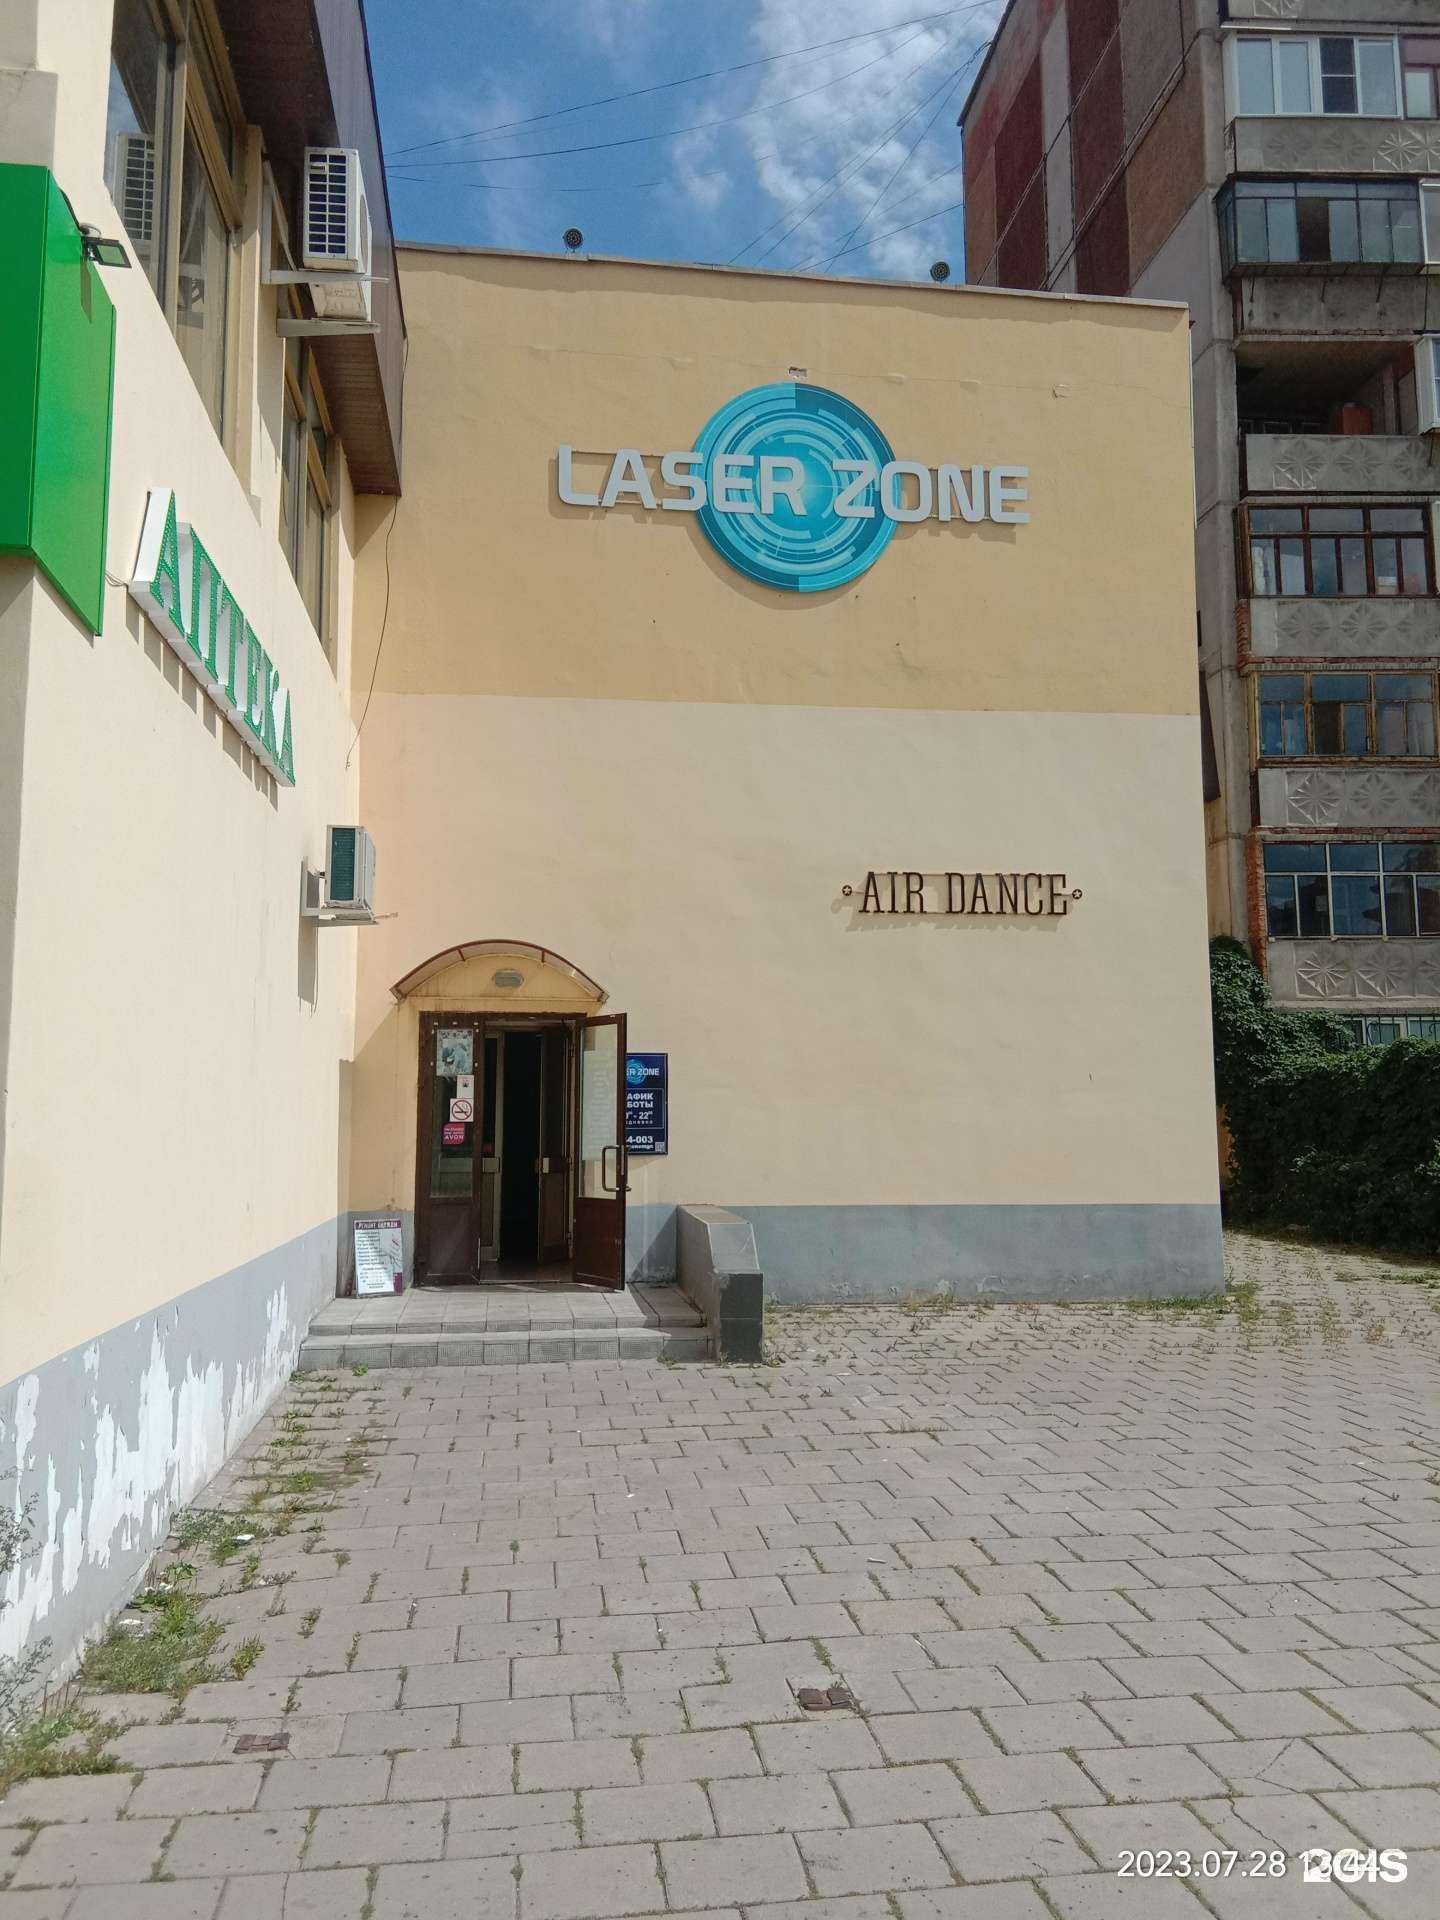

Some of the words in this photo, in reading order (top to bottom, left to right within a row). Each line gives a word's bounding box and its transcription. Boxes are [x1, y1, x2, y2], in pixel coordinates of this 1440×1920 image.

[558, 445, 807, 516] LASER
[832, 460, 1031, 524] ZONE
[148, 488, 296, 785] АПТЕКА
[858, 871, 927, 914] AIR
[945, 872, 1067, 915] DANCE
[638, 1067, 660, 1076] ZONE
[626, 1092, 654, 1100] АФИК
[626, 1135, 654, 1144] 4-003
